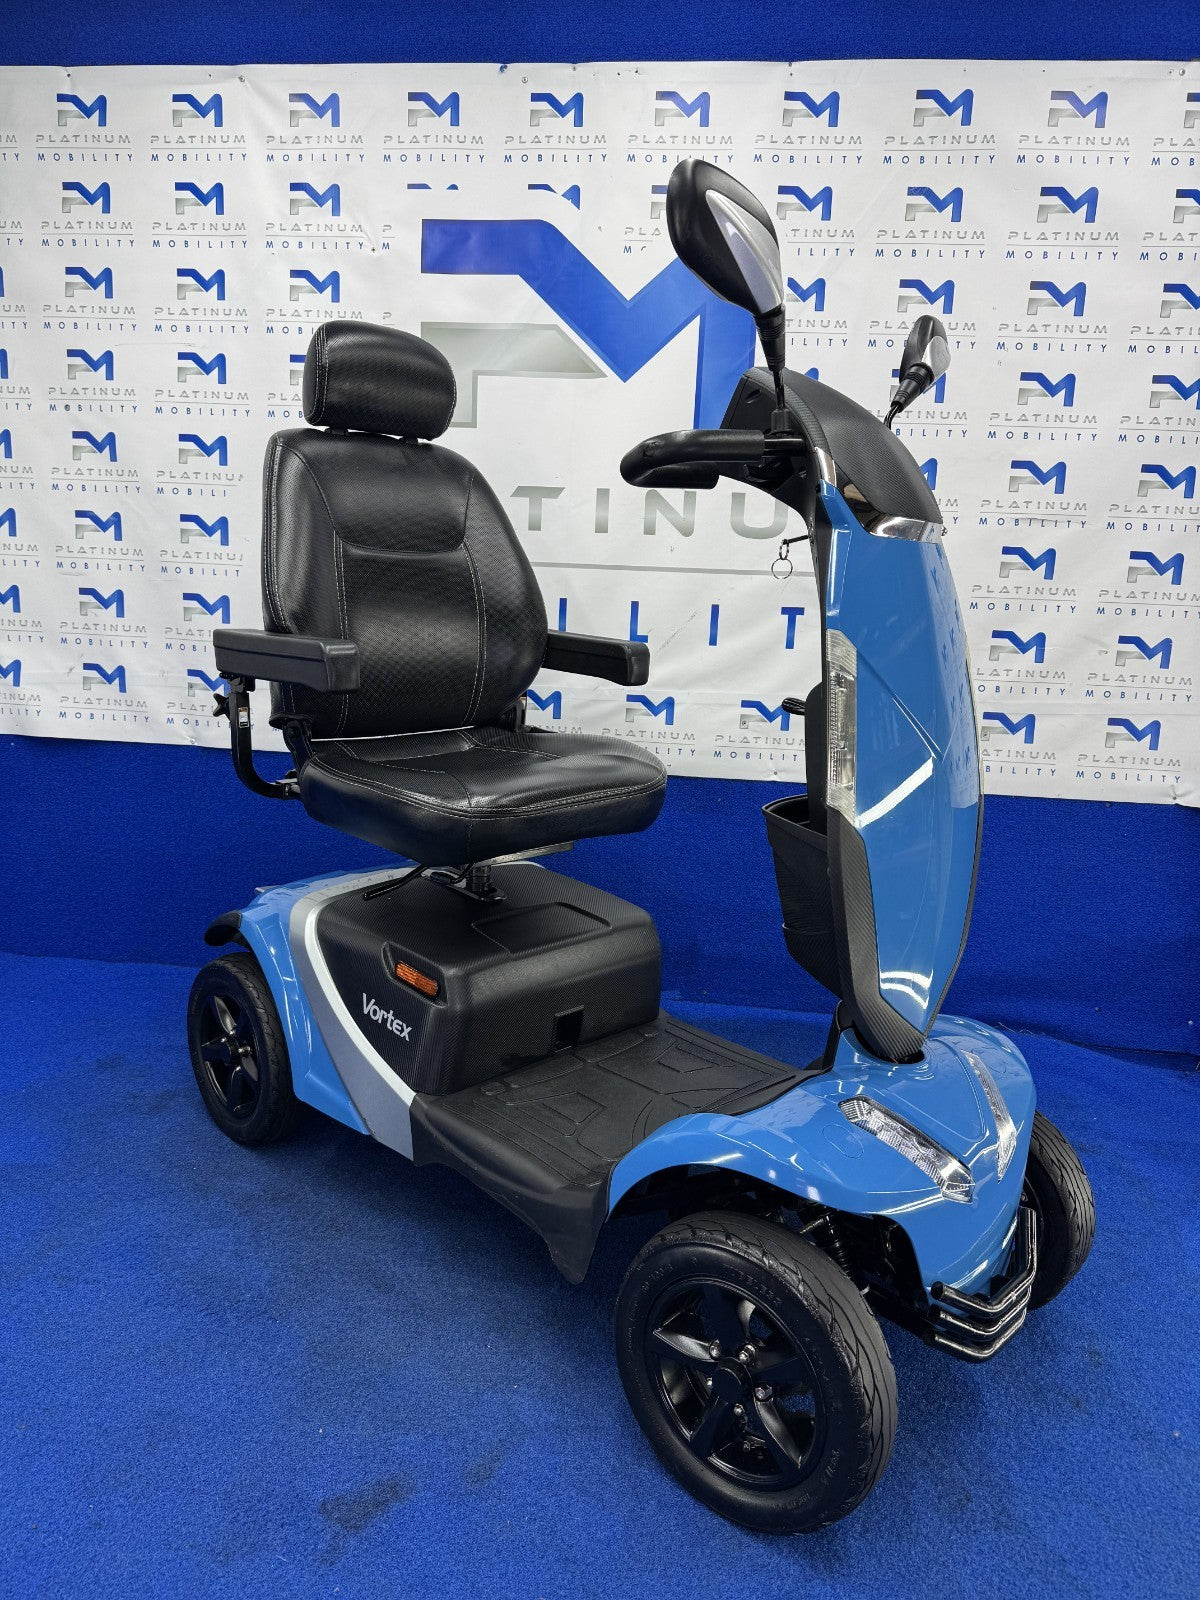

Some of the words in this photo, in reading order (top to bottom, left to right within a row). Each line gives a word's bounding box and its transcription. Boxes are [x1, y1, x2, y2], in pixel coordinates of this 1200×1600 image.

[36, 135, 131, 144] PLATINUM
[151, 135, 246, 144] PLATINUM
[266, 135, 364, 144] PLATINUM
[384, 135, 484, 145] PLATINUM
[505, 135, 606, 145] PLATINUM
[628, 135, 733, 145] PLATINUM
[755, 135, 862, 145] PLATINUM
[885, 134, 996, 145] PLATINUM
[1019, 135, 1130, 146] PLATINUM
[38, 153, 133, 162] MOBILITY
[151, 153, 247, 162] MOBILITY
[266, 154, 365, 163] MOBILITY
[384, 154, 485, 164] MOBILITY
[504, 154, 607, 163] MOBILITY
[627, 154, 733, 164] MOBIITY
[754, 154, 863, 164] MOBILITY
[883, 155, 996, 165] MOBILITY
[1016, 154, 1130, 165] MOBILITY
[41, 221, 133, 230] PLATINUM
[152, 222, 246, 231] PLATINUM
[266, 223, 363, 233] PLATINUM
[877, 230, 985, 240] PLATINUM
[1008, 232, 1119, 241] PLATINUM
[42, 239, 135, 247] MOBILITY
[152, 240, 247, 249] MOBILITY
[266, 240, 364, 250] MOBILITY
[875, 249, 985, 259] MOBILITY
[1006, 250, 1118, 261] MOBILITY
[43, 305, 135, 315] PLATINUM
[155, 307, 248, 316] PLATINUM
[266, 309, 363, 319] PLATINUM
[44, 322, 137, 332] MOBILITY
[154, 324, 249, 334] MOBILITY
[999, 323, 1108, 334] PLATINUM
[1131, 326, 1200, 336] PLATI
[996, 342, 1107, 353] MOBILITY
[49, 387, 136, 396] PLATINUM
[155, 390, 249, 400] PLATINUM
[49, 404, 138, 413] MOBILITY
[155, 406, 251, 417] MOBILITY
[990, 413, 1097, 424] PLATINUM
[988, 431, 1098, 441] MOBILITY
[52, 467, 139, 478] PLATINUM
[52, 483, 141, 494] MOBILITY
[157, 487, 226, 497] MOBILI
[981, 500, 1087, 511] PLATINUM
[978, 517, 1087, 530] MOBILITY
[56, 546, 144, 556] PLATINUM
[160, 550, 243, 561] PLATINU
[56, 561, 145, 572] MOBILITY
[161, 566, 240, 577] MOBILIT
[972, 585, 1076, 596] PLATINUM
[969, 601, 1076, 614] MOBILITY
[60, 622, 147, 633] PLATINUM
[60, 637, 148, 649] MOBILITY
[1088, 673, 1192, 685] PLATINUM
[1086, 690, 1192, 702] MOBILITY
[61, 696, 147, 708] PLATINUM
[59, 711, 149, 723] MOBILITY
[602, 728, 695, 740] PLATINUM
[714, 751, 798, 762] MOBILIT
[1078, 754, 1181, 767] PLATINUM
[1076, 771, 1181, 783] MOBILITY
[362, 992, 412, 1042] Vortex
